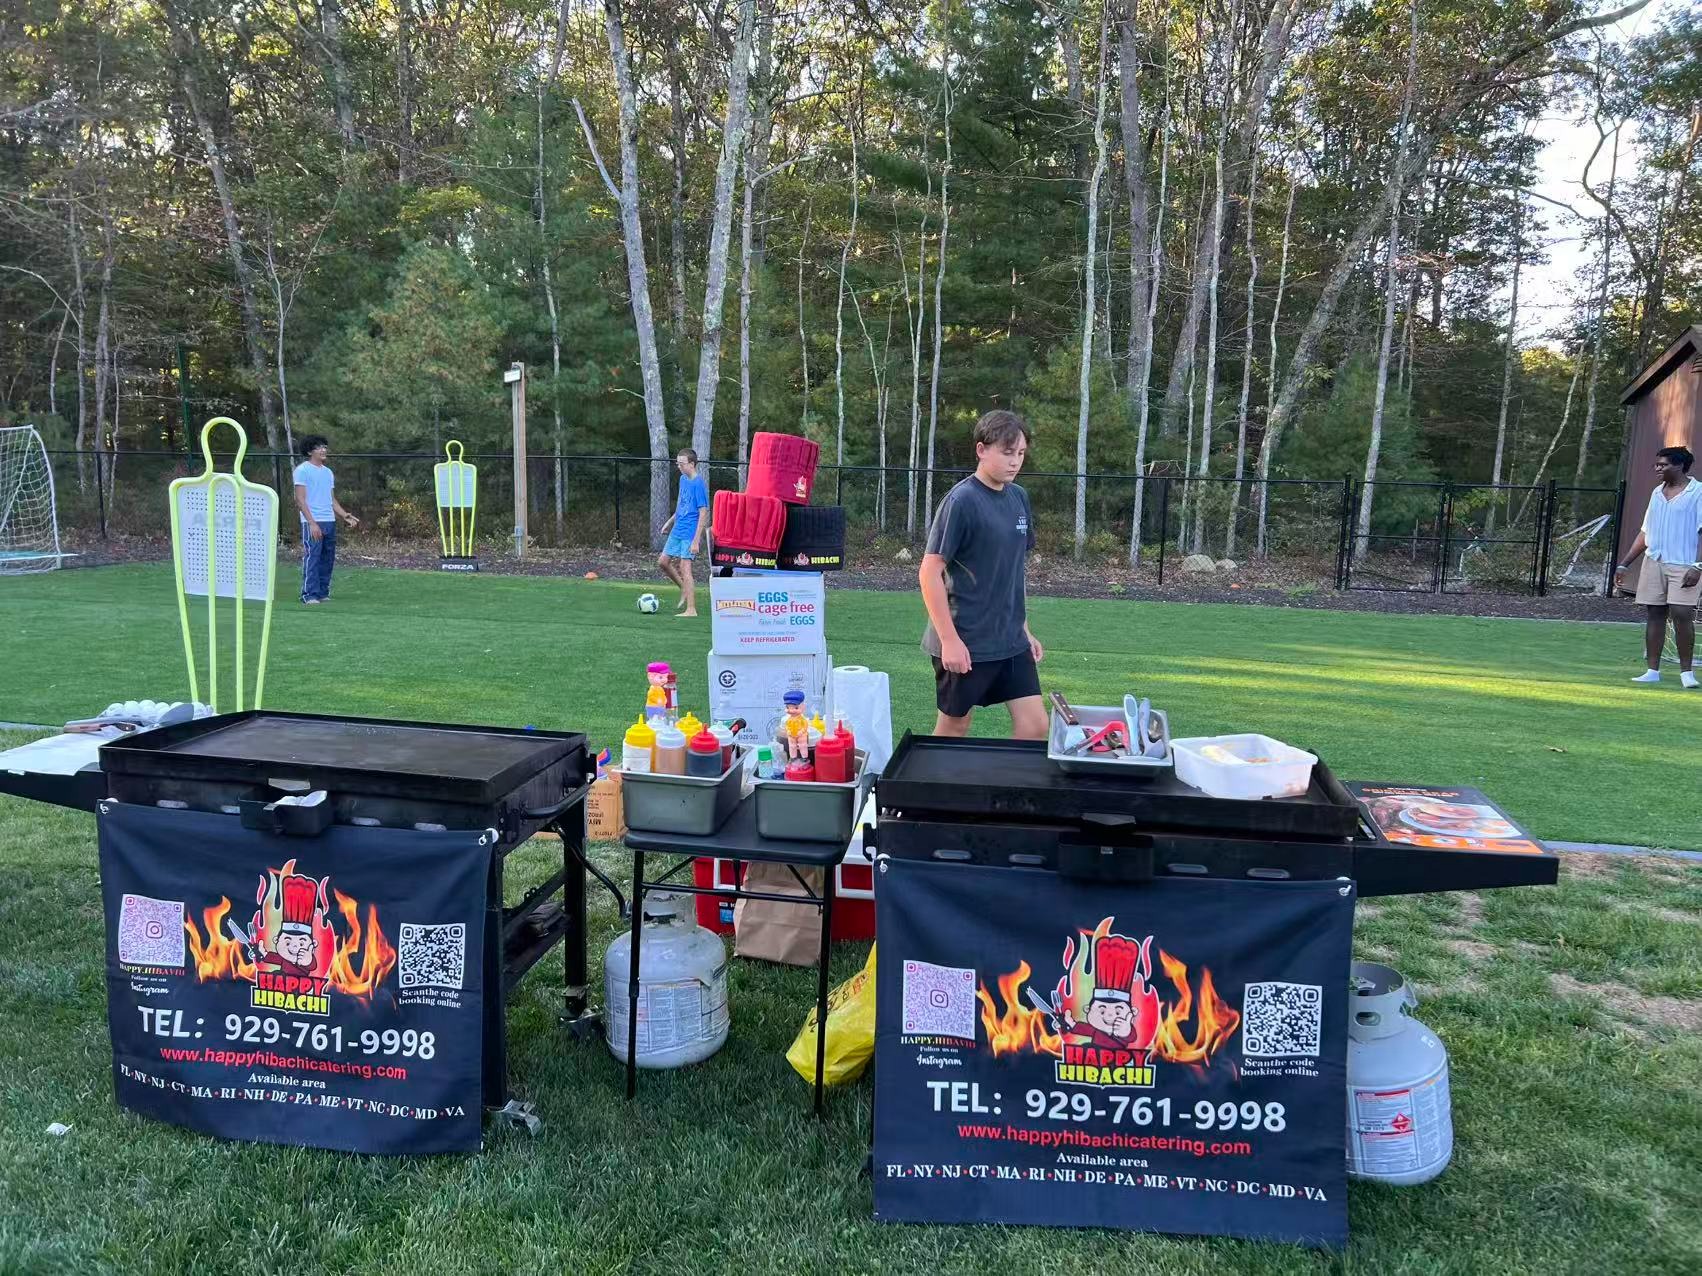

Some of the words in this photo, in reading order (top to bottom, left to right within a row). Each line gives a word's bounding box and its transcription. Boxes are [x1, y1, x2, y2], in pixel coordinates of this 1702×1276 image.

[758, 592, 788, 602] EGGS
[758, 604, 787, 616] cage
[790, 600, 814, 612] free
[790, 616, 815, 626] EGGS
[259, 973, 326, 996] HAPPY
[254, 989, 327, 1013] HIBACHI
[399, 996, 436, 1006] booking
[436, 998, 461, 1008] online
[440, 990, 459, 999] code
[138, 1006, 204, 1039] TEL:
[225, 1014, 436, 1060] 929-761-9998
[916, 1054, 962, 1068] Instagram
[1066, 1045, 1146, 1066] HAPPY
[1290, 1058, 1315, 1066] code
[160, 1048, 407, 1080] www.happyhibachicatering.com
[1240, 1067, 1282, 1076] booking
[1284, 1067, 1319, 1076] online
[248, 1072, 299, 1086] Available
[302, 1080, 326, 1089] area
[1059, 1064, 1152, 1085] HIBACHI
[926, 1080, 1002, 1115] TEL:
[1026, 1088, 1286, 1132] 929-761-9998
[958, 1125, 1251, 1156] www.happyhibachicatering.com
[1056, 1152, 1116, 1166] Available
[1120, 1157, 1148, 1168] area
